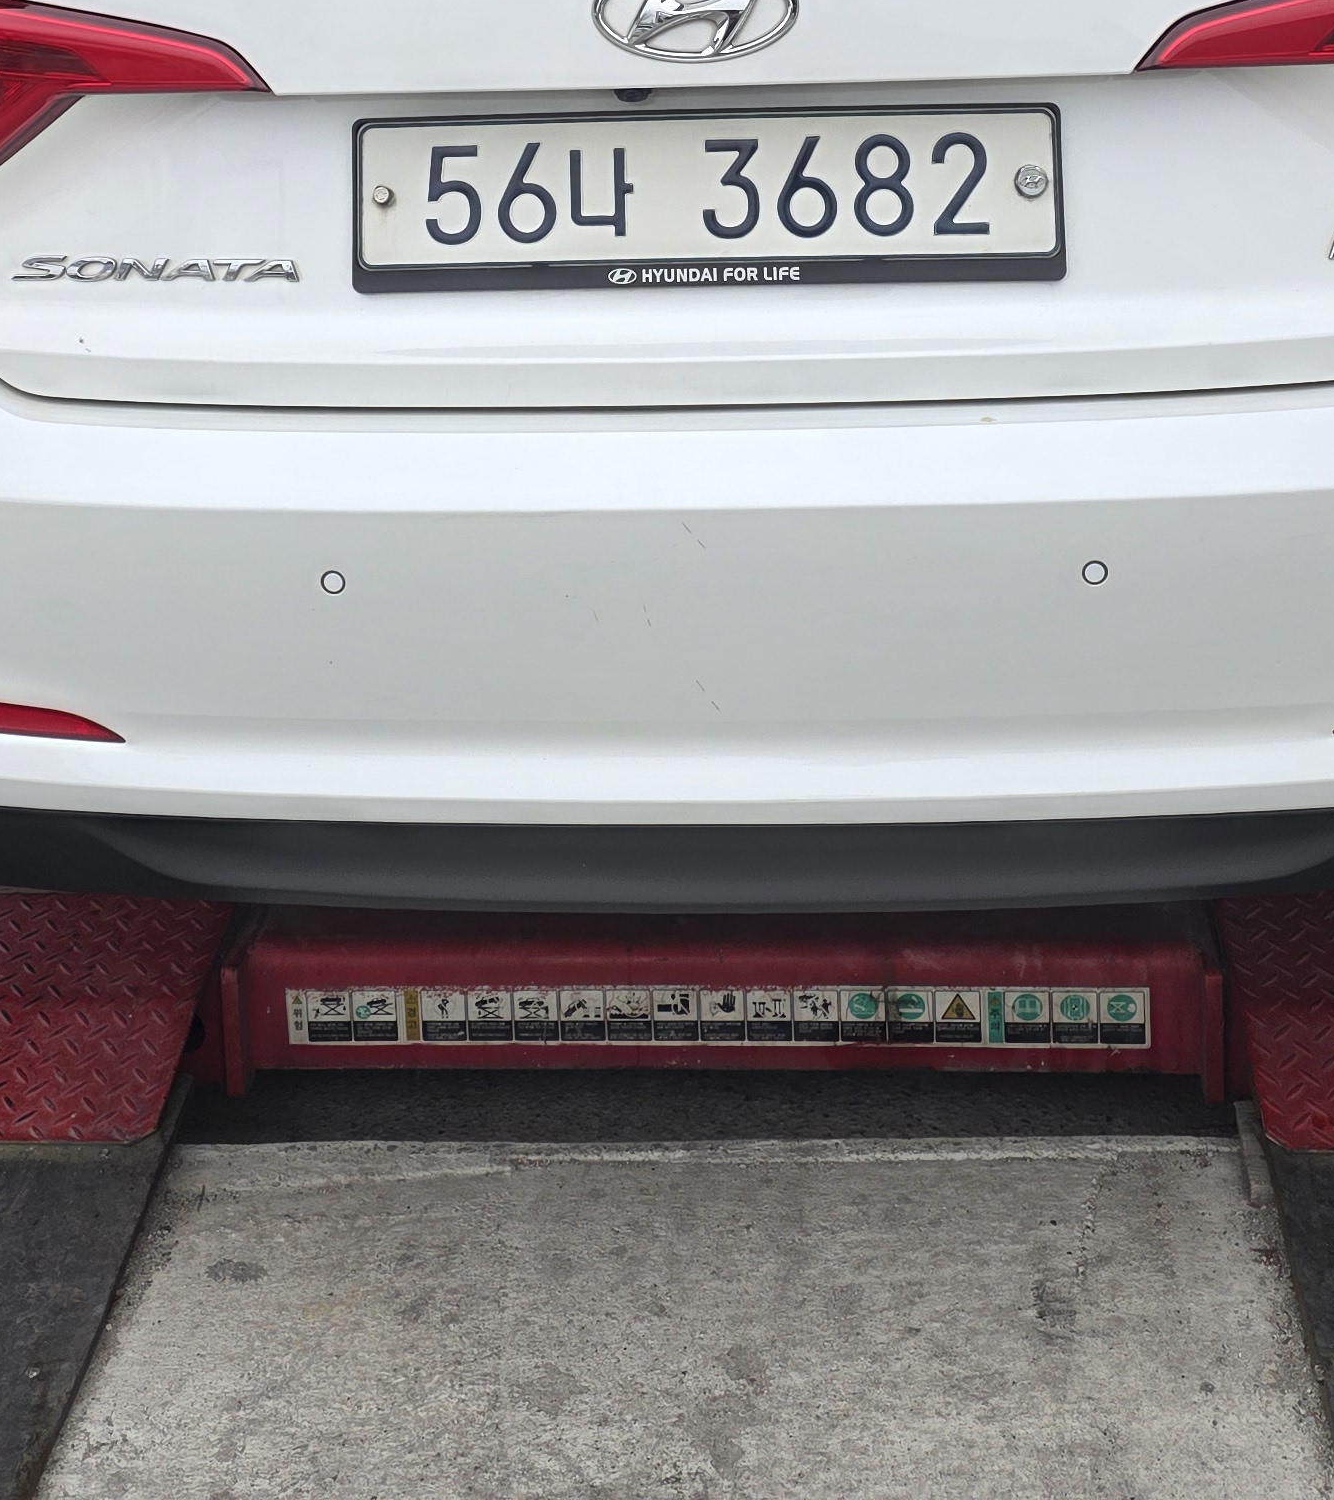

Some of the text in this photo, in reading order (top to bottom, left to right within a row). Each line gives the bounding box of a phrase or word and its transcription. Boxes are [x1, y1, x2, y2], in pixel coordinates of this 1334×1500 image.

[425, 131, 990, 246] 56나 3682
[12, 254, 300, 283] SONATA
[642, 265, 801, 283] HYUNDAI FOR LIFE
[292, 1007, 304, 1031] 위험
